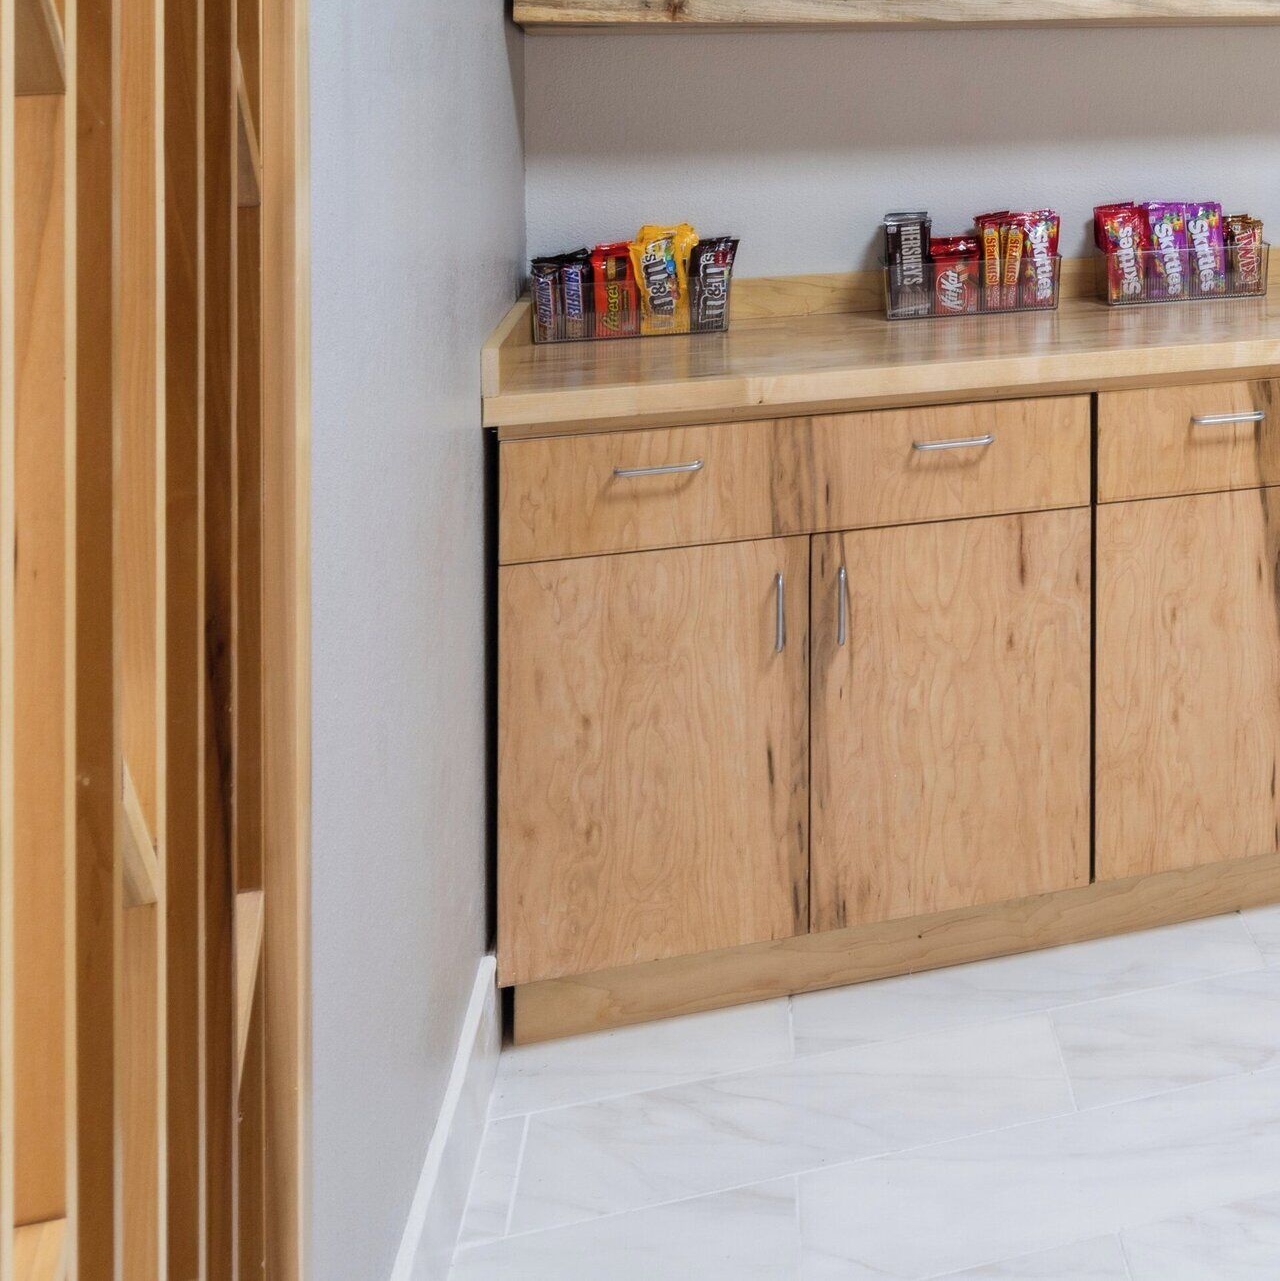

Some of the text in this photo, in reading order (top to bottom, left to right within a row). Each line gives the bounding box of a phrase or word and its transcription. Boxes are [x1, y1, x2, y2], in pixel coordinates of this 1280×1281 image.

[1117, 226, 1141, 295] Skittles
[1154, 223, 1183, 295] Skittles
[1188, 220, 1216, 292] Skittles
[1235, 229, 1260, 283] TWIX
